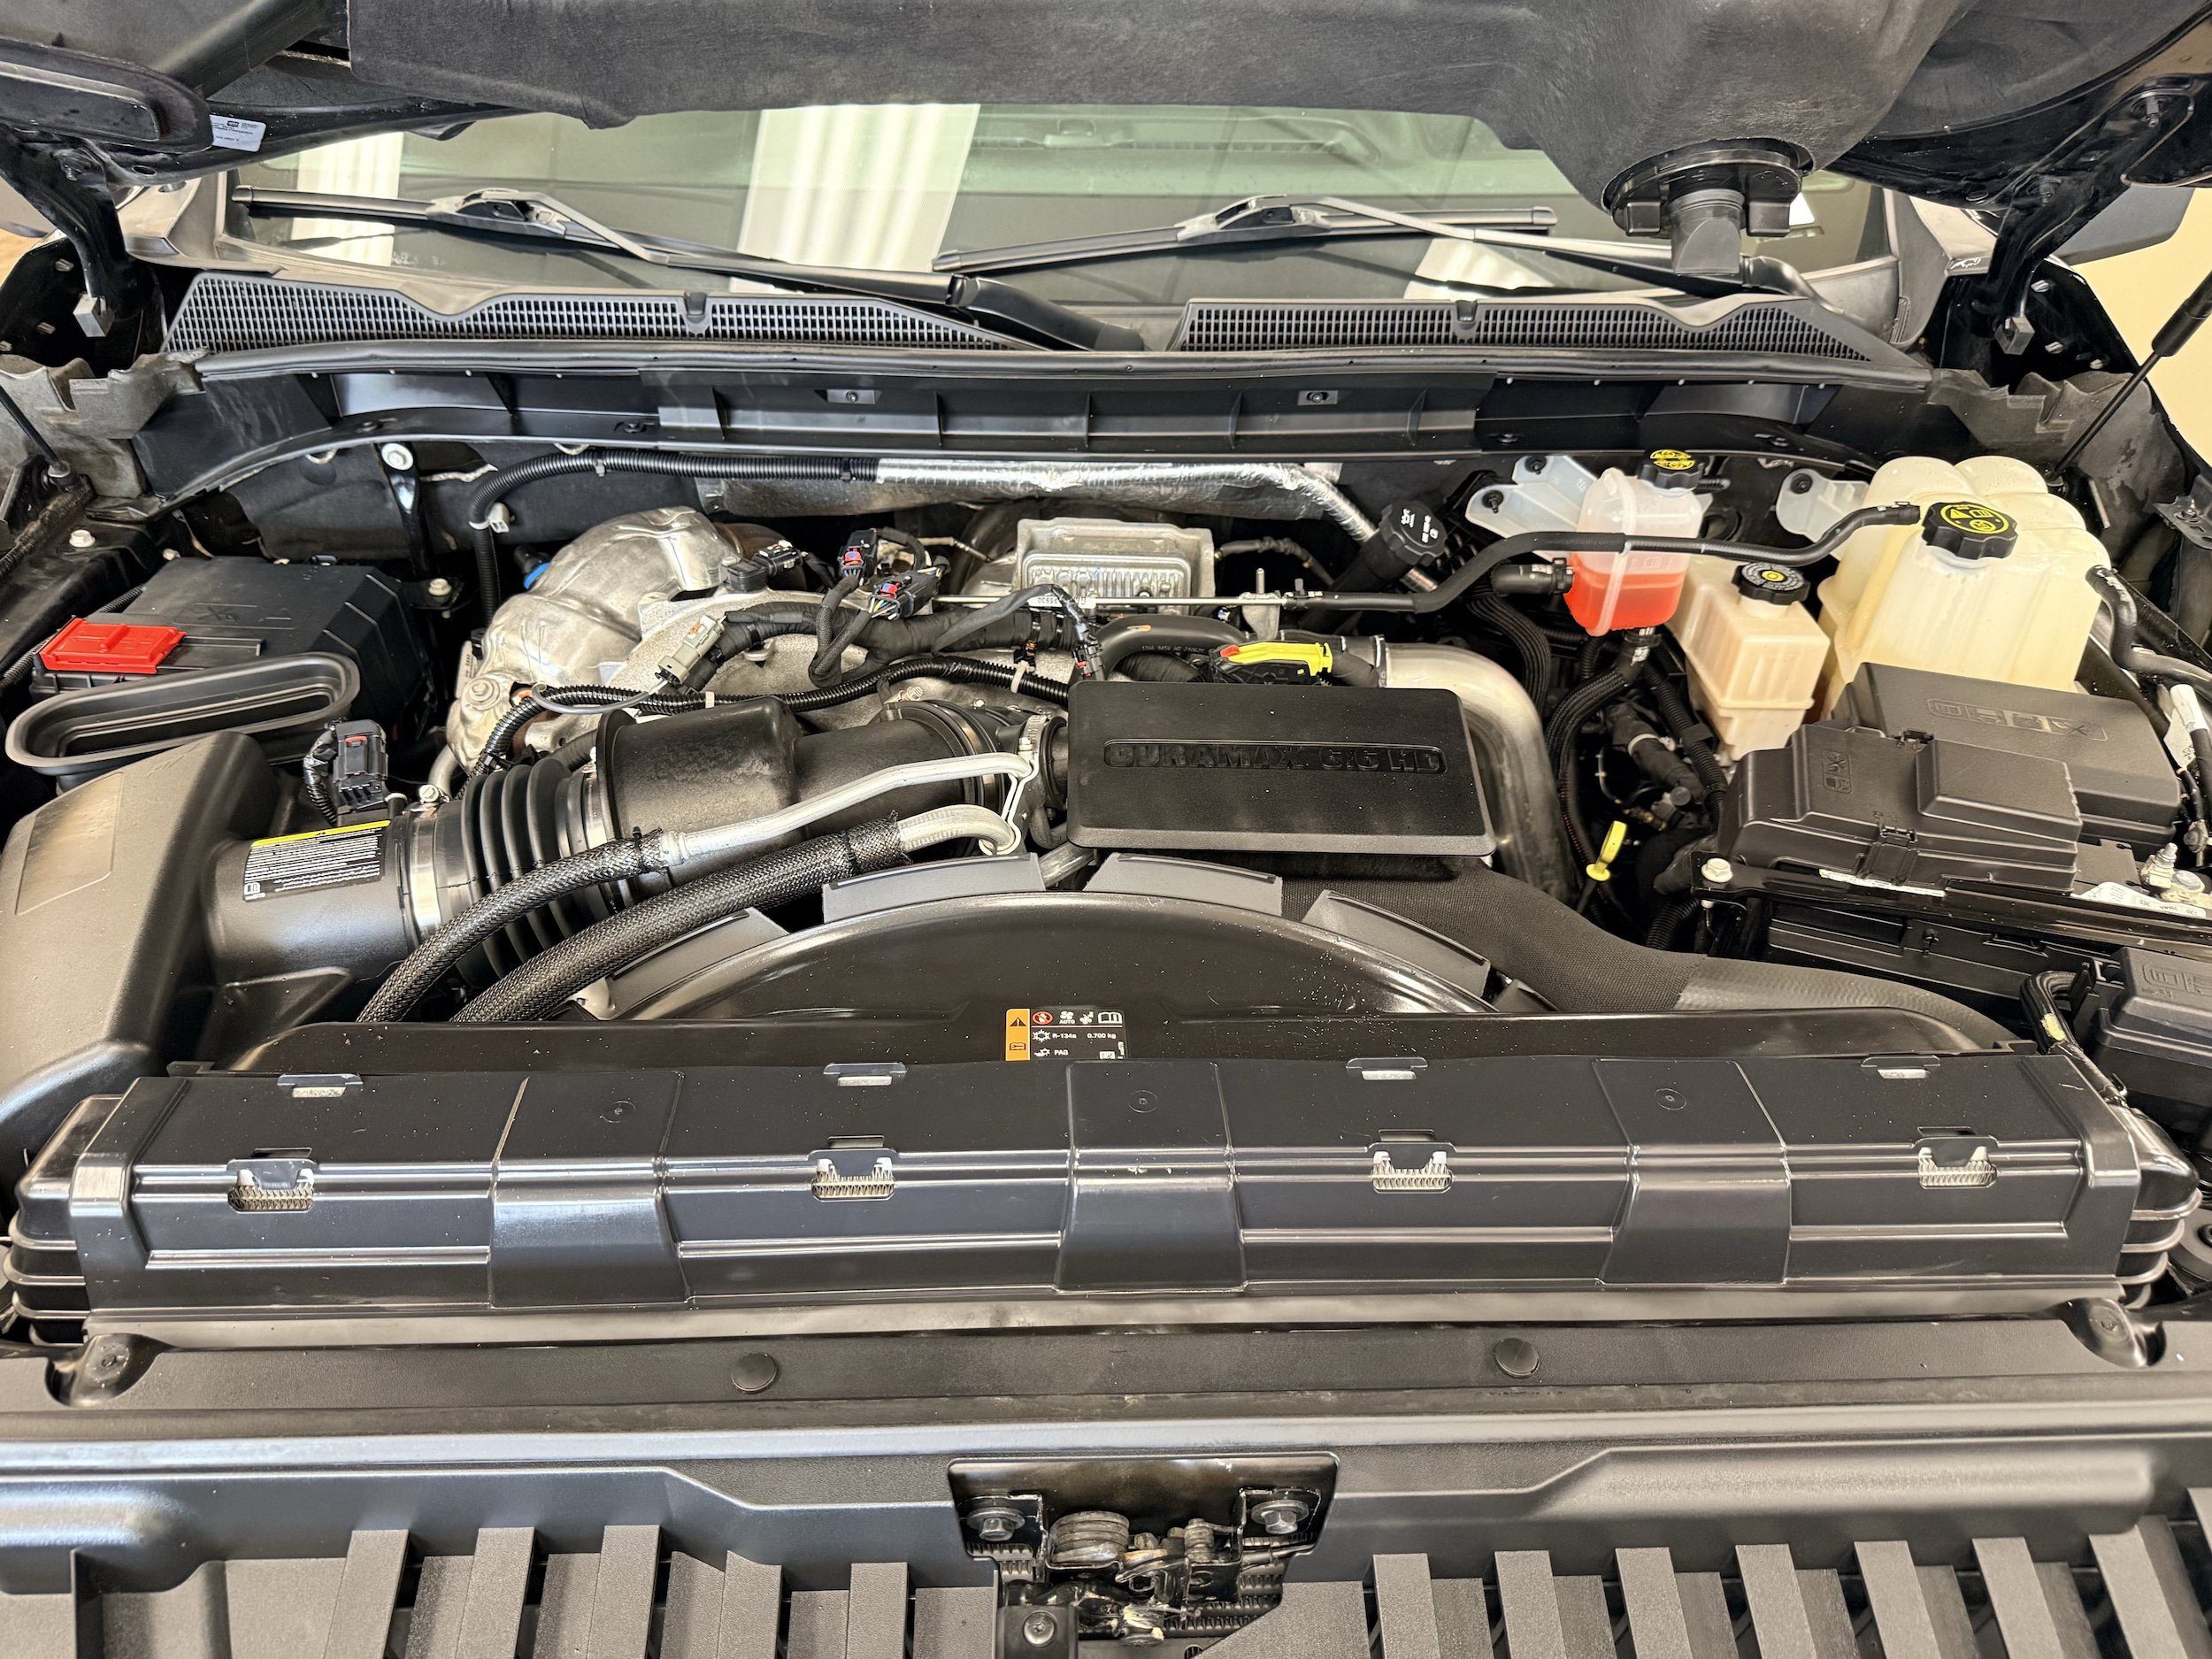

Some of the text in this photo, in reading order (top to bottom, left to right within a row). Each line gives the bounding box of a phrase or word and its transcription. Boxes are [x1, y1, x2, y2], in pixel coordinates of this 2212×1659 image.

[1110, 744, 1442, 772] DURAMAX 6.6 HD
